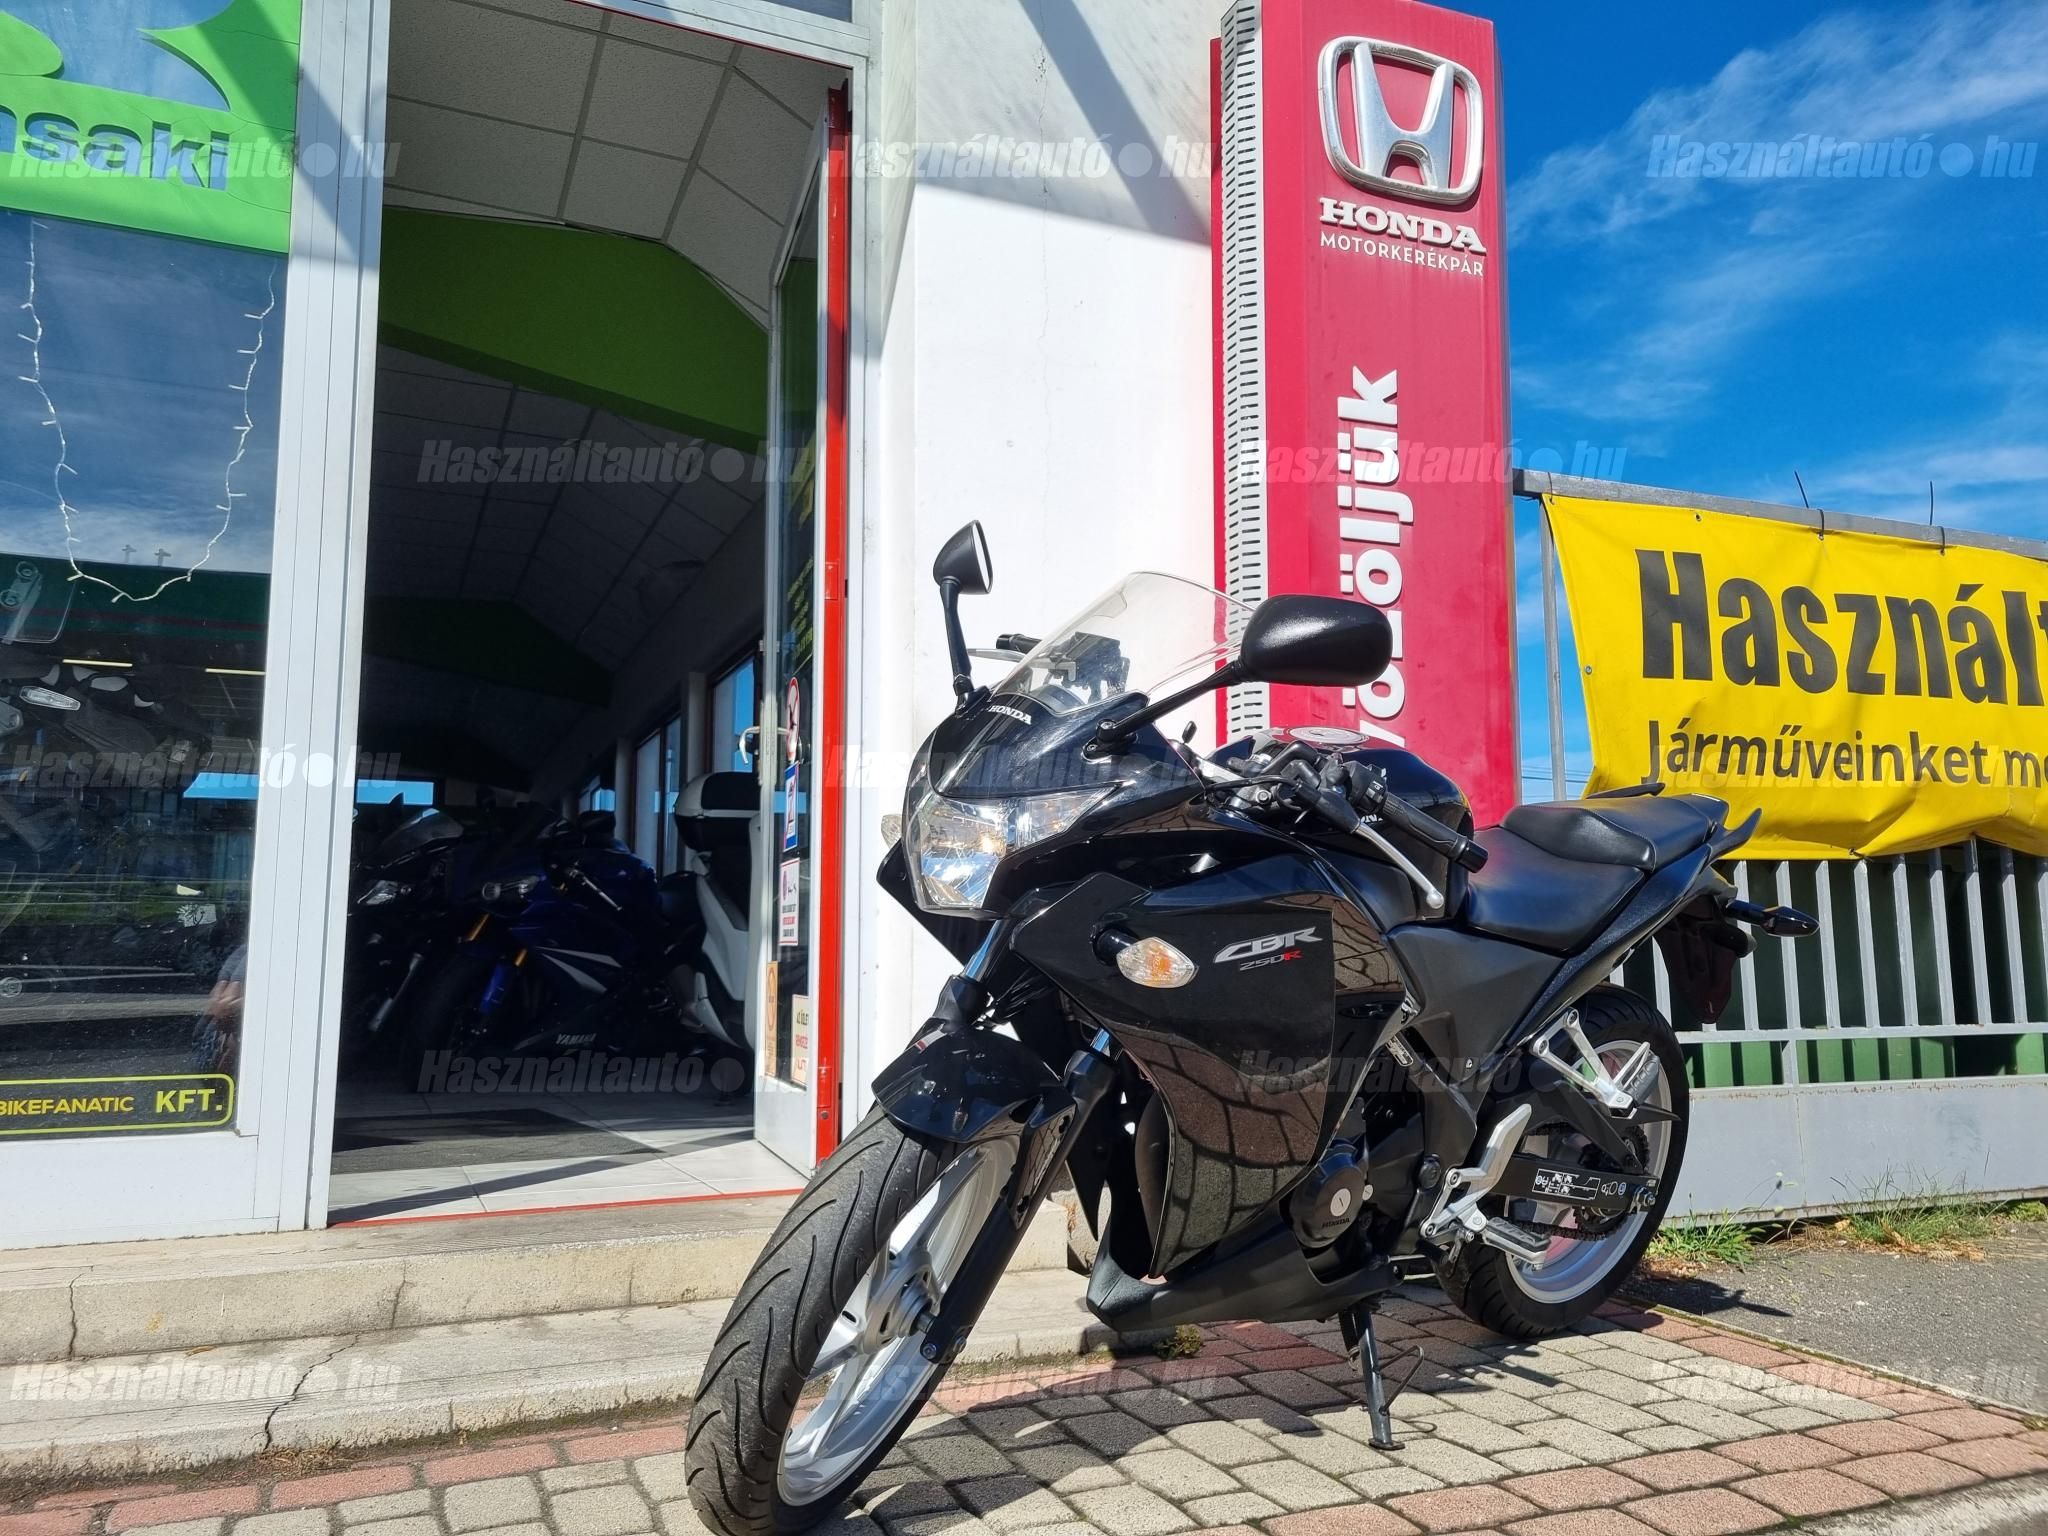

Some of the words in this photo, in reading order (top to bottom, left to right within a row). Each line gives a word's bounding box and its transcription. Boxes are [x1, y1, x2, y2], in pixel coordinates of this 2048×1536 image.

[0, 103, 229, 191] saki
[1319, 197, 1487, 255] HONDA
[1320, 231, 1484, 277] MOTORKERÉKPÁR
[988, 705, 1032, 726] HONDA
[1641, 717, 1991, 784] Járműveinket
[2003, 749, 2048, 788] m
[1213, 926, 1322, 963] CBR
[156, 1089, 223, 1113] KFT.
